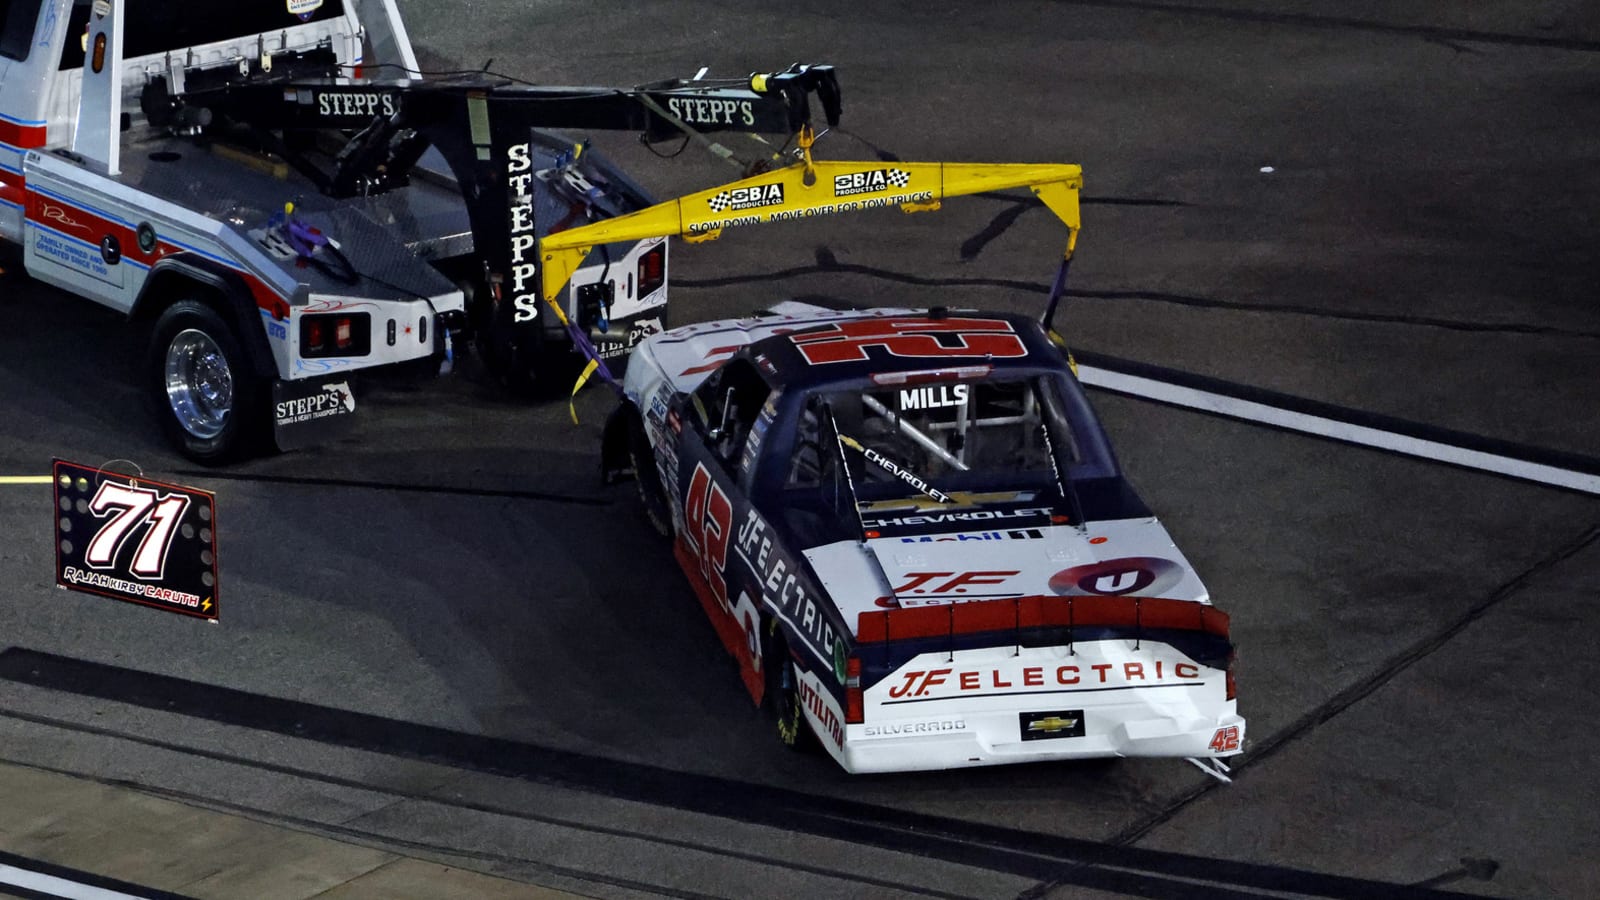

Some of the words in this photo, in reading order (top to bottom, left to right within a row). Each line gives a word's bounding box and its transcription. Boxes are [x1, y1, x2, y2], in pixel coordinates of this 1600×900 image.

[319, 92, 394, 115] STEPP'S
[668, 98, 755, 126] STEPP'S
[750, 184, 782, 201] B/A
[835, 185, 873, 196] PRODUCTS
[853, 171, 886, 187] B/A
[689, 221, 721, 233] SLOW
[724, 216, 761, 229] DOWN
[770, 210, 802, 222] MOVE
[805, 205, 834, 218] OVER
[837, 202, 858, 213] FOR
[861, 198, 888, 209] TOW
[889, 191, 932, 204] TRUCKS
[732, 200, 770, 210] PRODUCTS
[507, 143, 537, 323] STEPPS
[276, 392, 339, 418] STEPP'S
[900, 384, 969, 411] MILLS
[864, 448, 949, 503] CHEVROLET
[85, 480, 191, 580] 71
[862, 507, 1054, 528] CHEVROLET
[685, 460, 733, 614] 42
[64, 566, 110, 587] RAJAH
[109, 578, 145, 595] KIRBY
[145, 585, 200, 608] CARUTH
[960, 661, 1199, 690] ELECTRIC
[800, 679, 844, 752] UTILITRA
[864, 720, 966, 736] SILVERADO
[1208, 726, 1240, 753] 42
